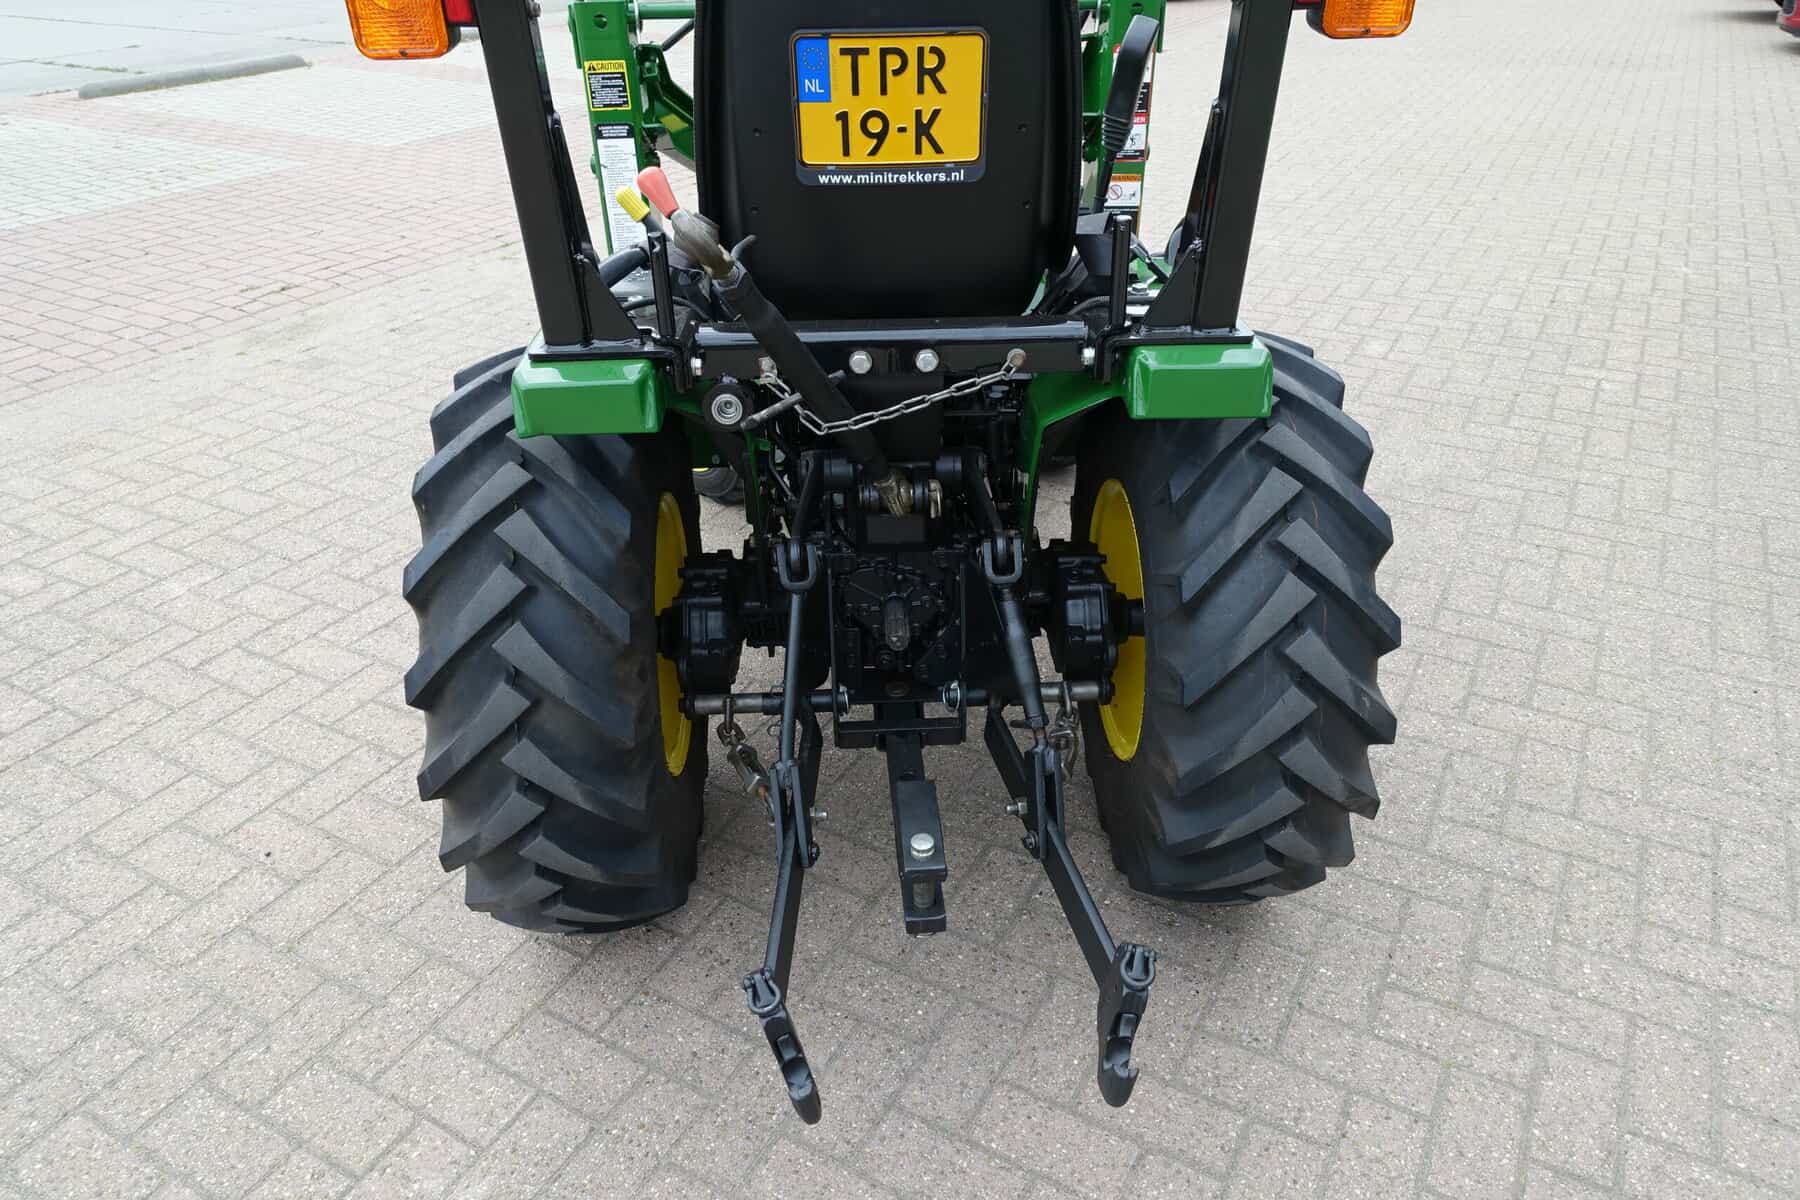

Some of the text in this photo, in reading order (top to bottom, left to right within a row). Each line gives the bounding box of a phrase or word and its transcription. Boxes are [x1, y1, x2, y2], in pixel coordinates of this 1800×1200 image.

[596, 62, 624, 71] CAUTION
[839, 46, 947, 96] TPR
[804, 79, 825, 93] NL
[835, 108, 944, 157] 19-K
[818, 169, 964, 184] www.minitrekkers.nl
